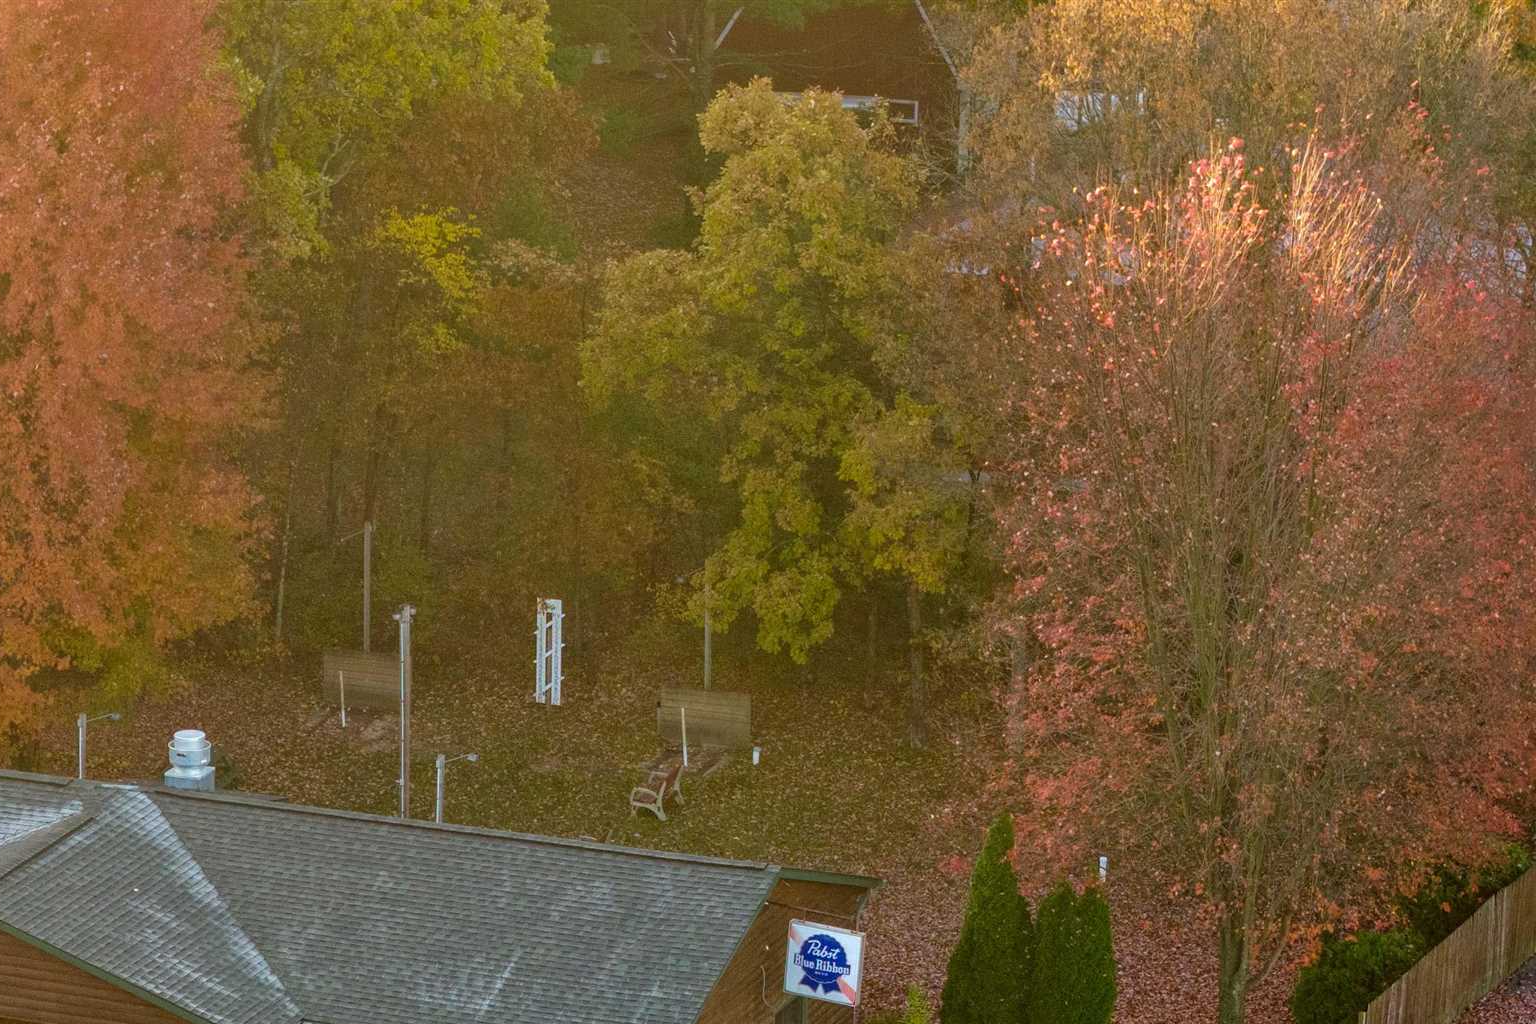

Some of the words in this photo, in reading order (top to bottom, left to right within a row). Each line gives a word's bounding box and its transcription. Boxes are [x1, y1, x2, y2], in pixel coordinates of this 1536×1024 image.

[808, 939, 840, 960] Pabst
[795, 953, 815, 969] Blue
[816, 959, 850, 975] Ribbon
